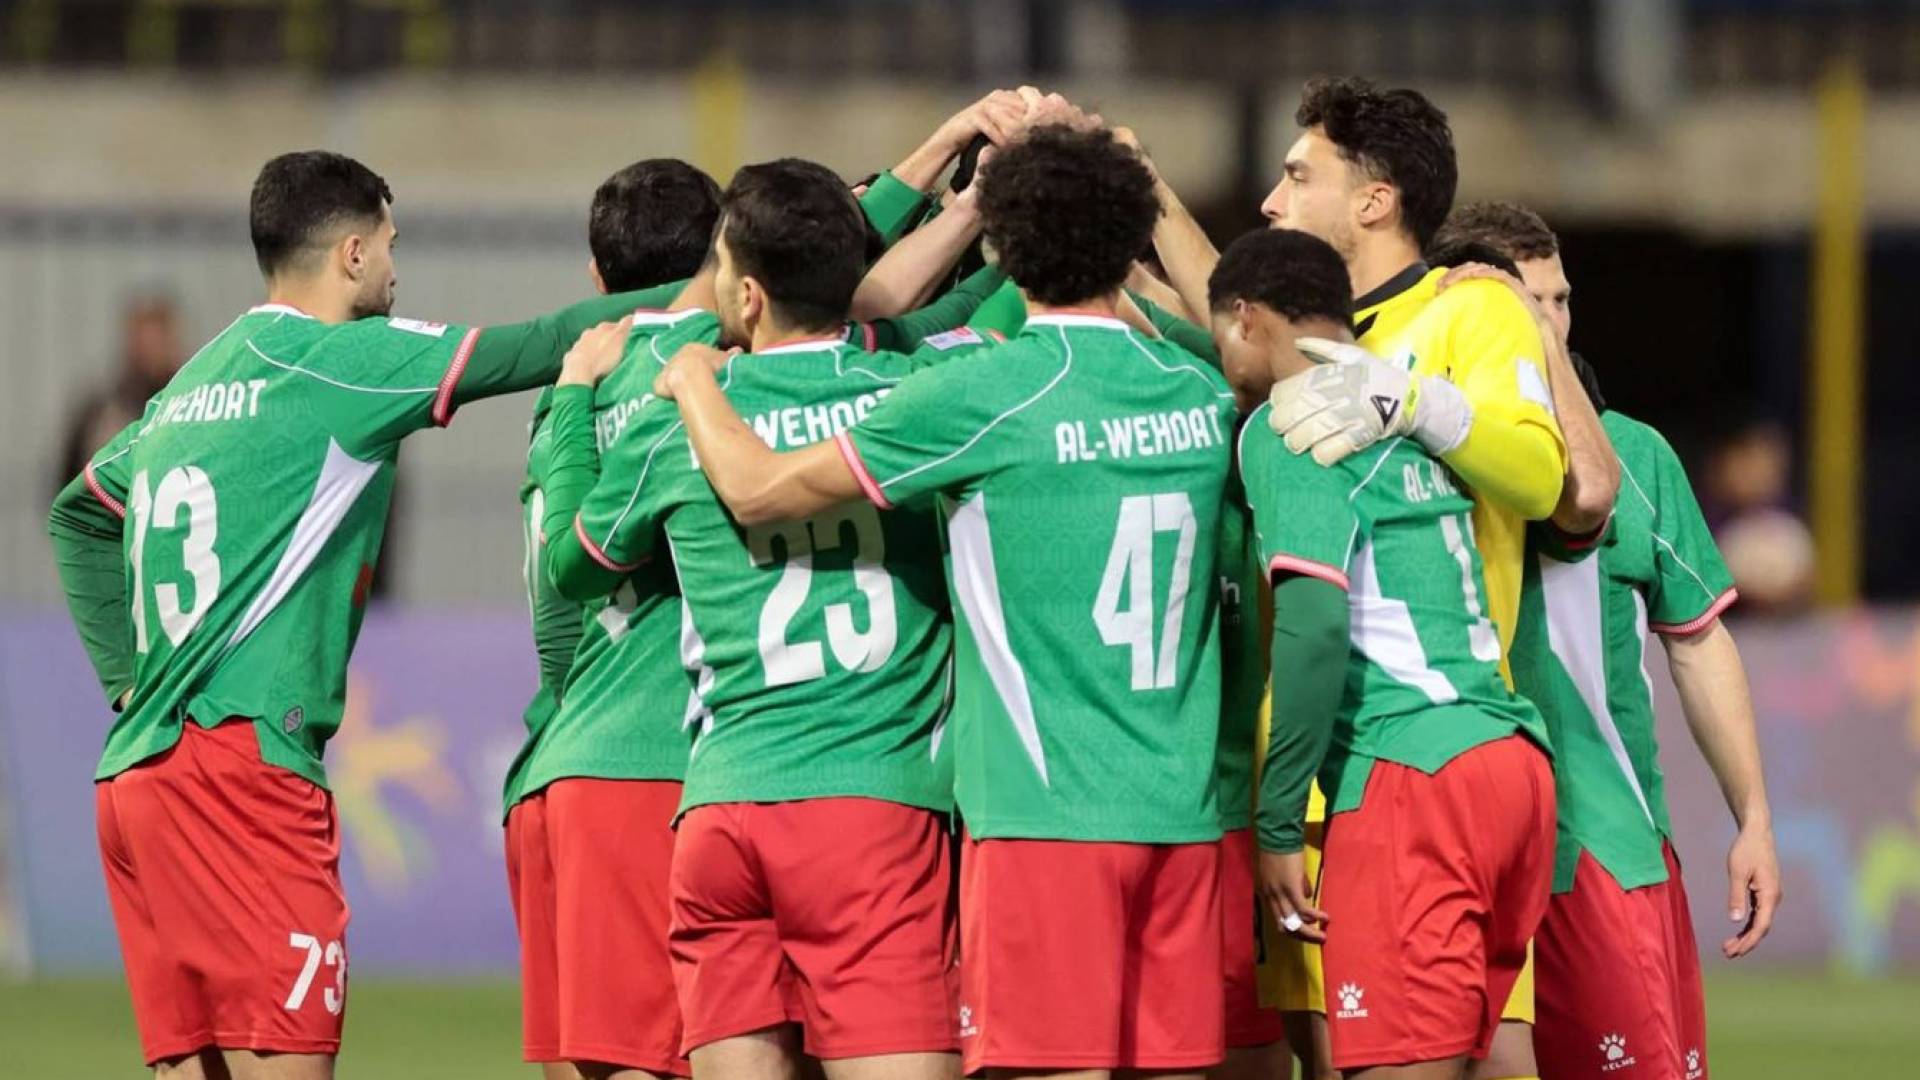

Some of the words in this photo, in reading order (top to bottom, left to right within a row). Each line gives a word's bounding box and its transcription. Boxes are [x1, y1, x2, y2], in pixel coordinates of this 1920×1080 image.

[1055, 404, 1224, 464] AL-WEHDAT
[747, 501, 897, 687] 23
[1092, 491, 1198, 691] 47
[284, 932, 346, 1016] 73
